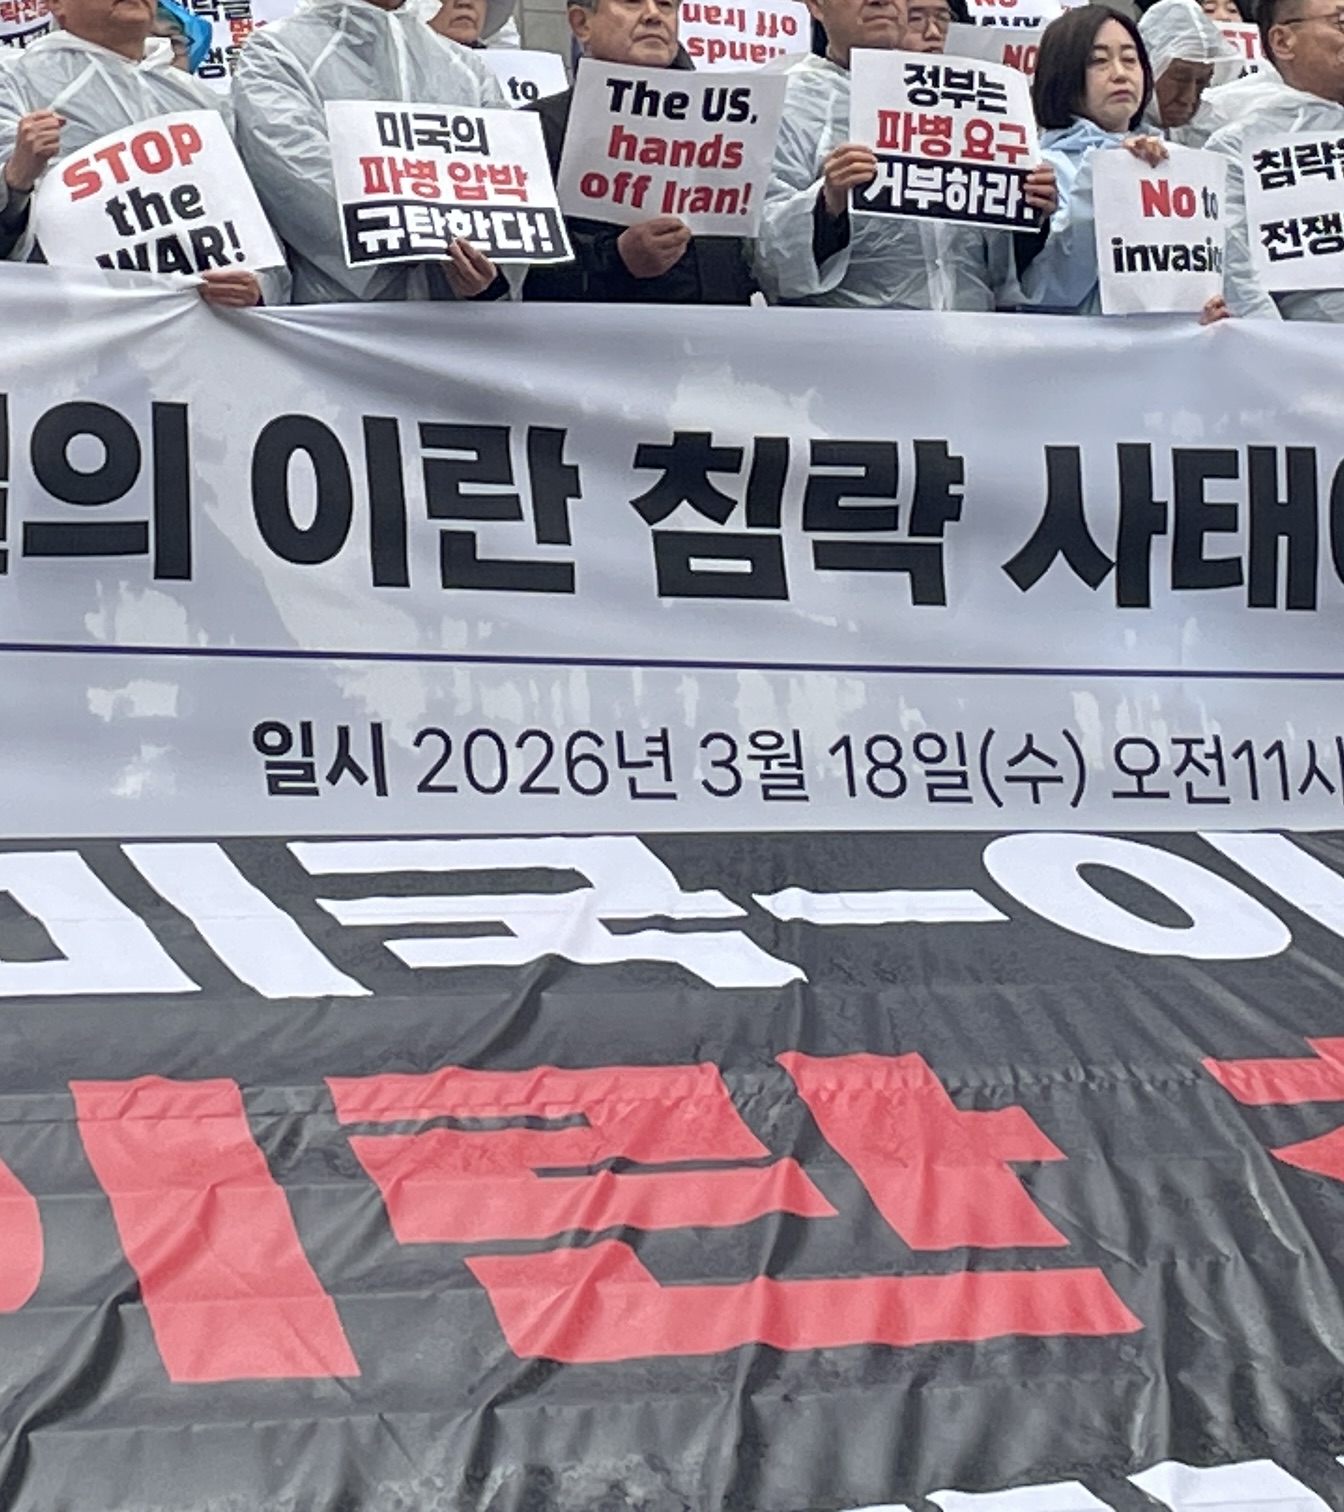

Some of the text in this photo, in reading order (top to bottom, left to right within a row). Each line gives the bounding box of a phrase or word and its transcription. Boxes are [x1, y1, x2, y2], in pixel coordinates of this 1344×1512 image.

[686, 37, 786, 64] ands
[507, 76, 539, 102] to
[606, 78, 690, 121] The
[903, 63, 1008, 115] 정부는
[375, 111, 491, 157] 미국의
[607, 125, 744, 169] hands
[876, 109, 1030, 164] 파병 요구
[62, 123, 204, 202] STOP
[359, 157, 529, 202] 파병 압박
[105, 183, 207, 237] the
[580, 171, 753, 216] off Iran!
[1140, 179, 1219, 220] No to
[357, 205, 554, 254] 규탄한다!
[250, 413, 583, 595] 이란
[628, 430, 965, 608] 침략
[251, 719, 390, 799] 일시
[411, 727, 679, 803] 2026년
[699, 729, 812, 803] 3월
[828, 728, 1088, 808] 18일(수)
